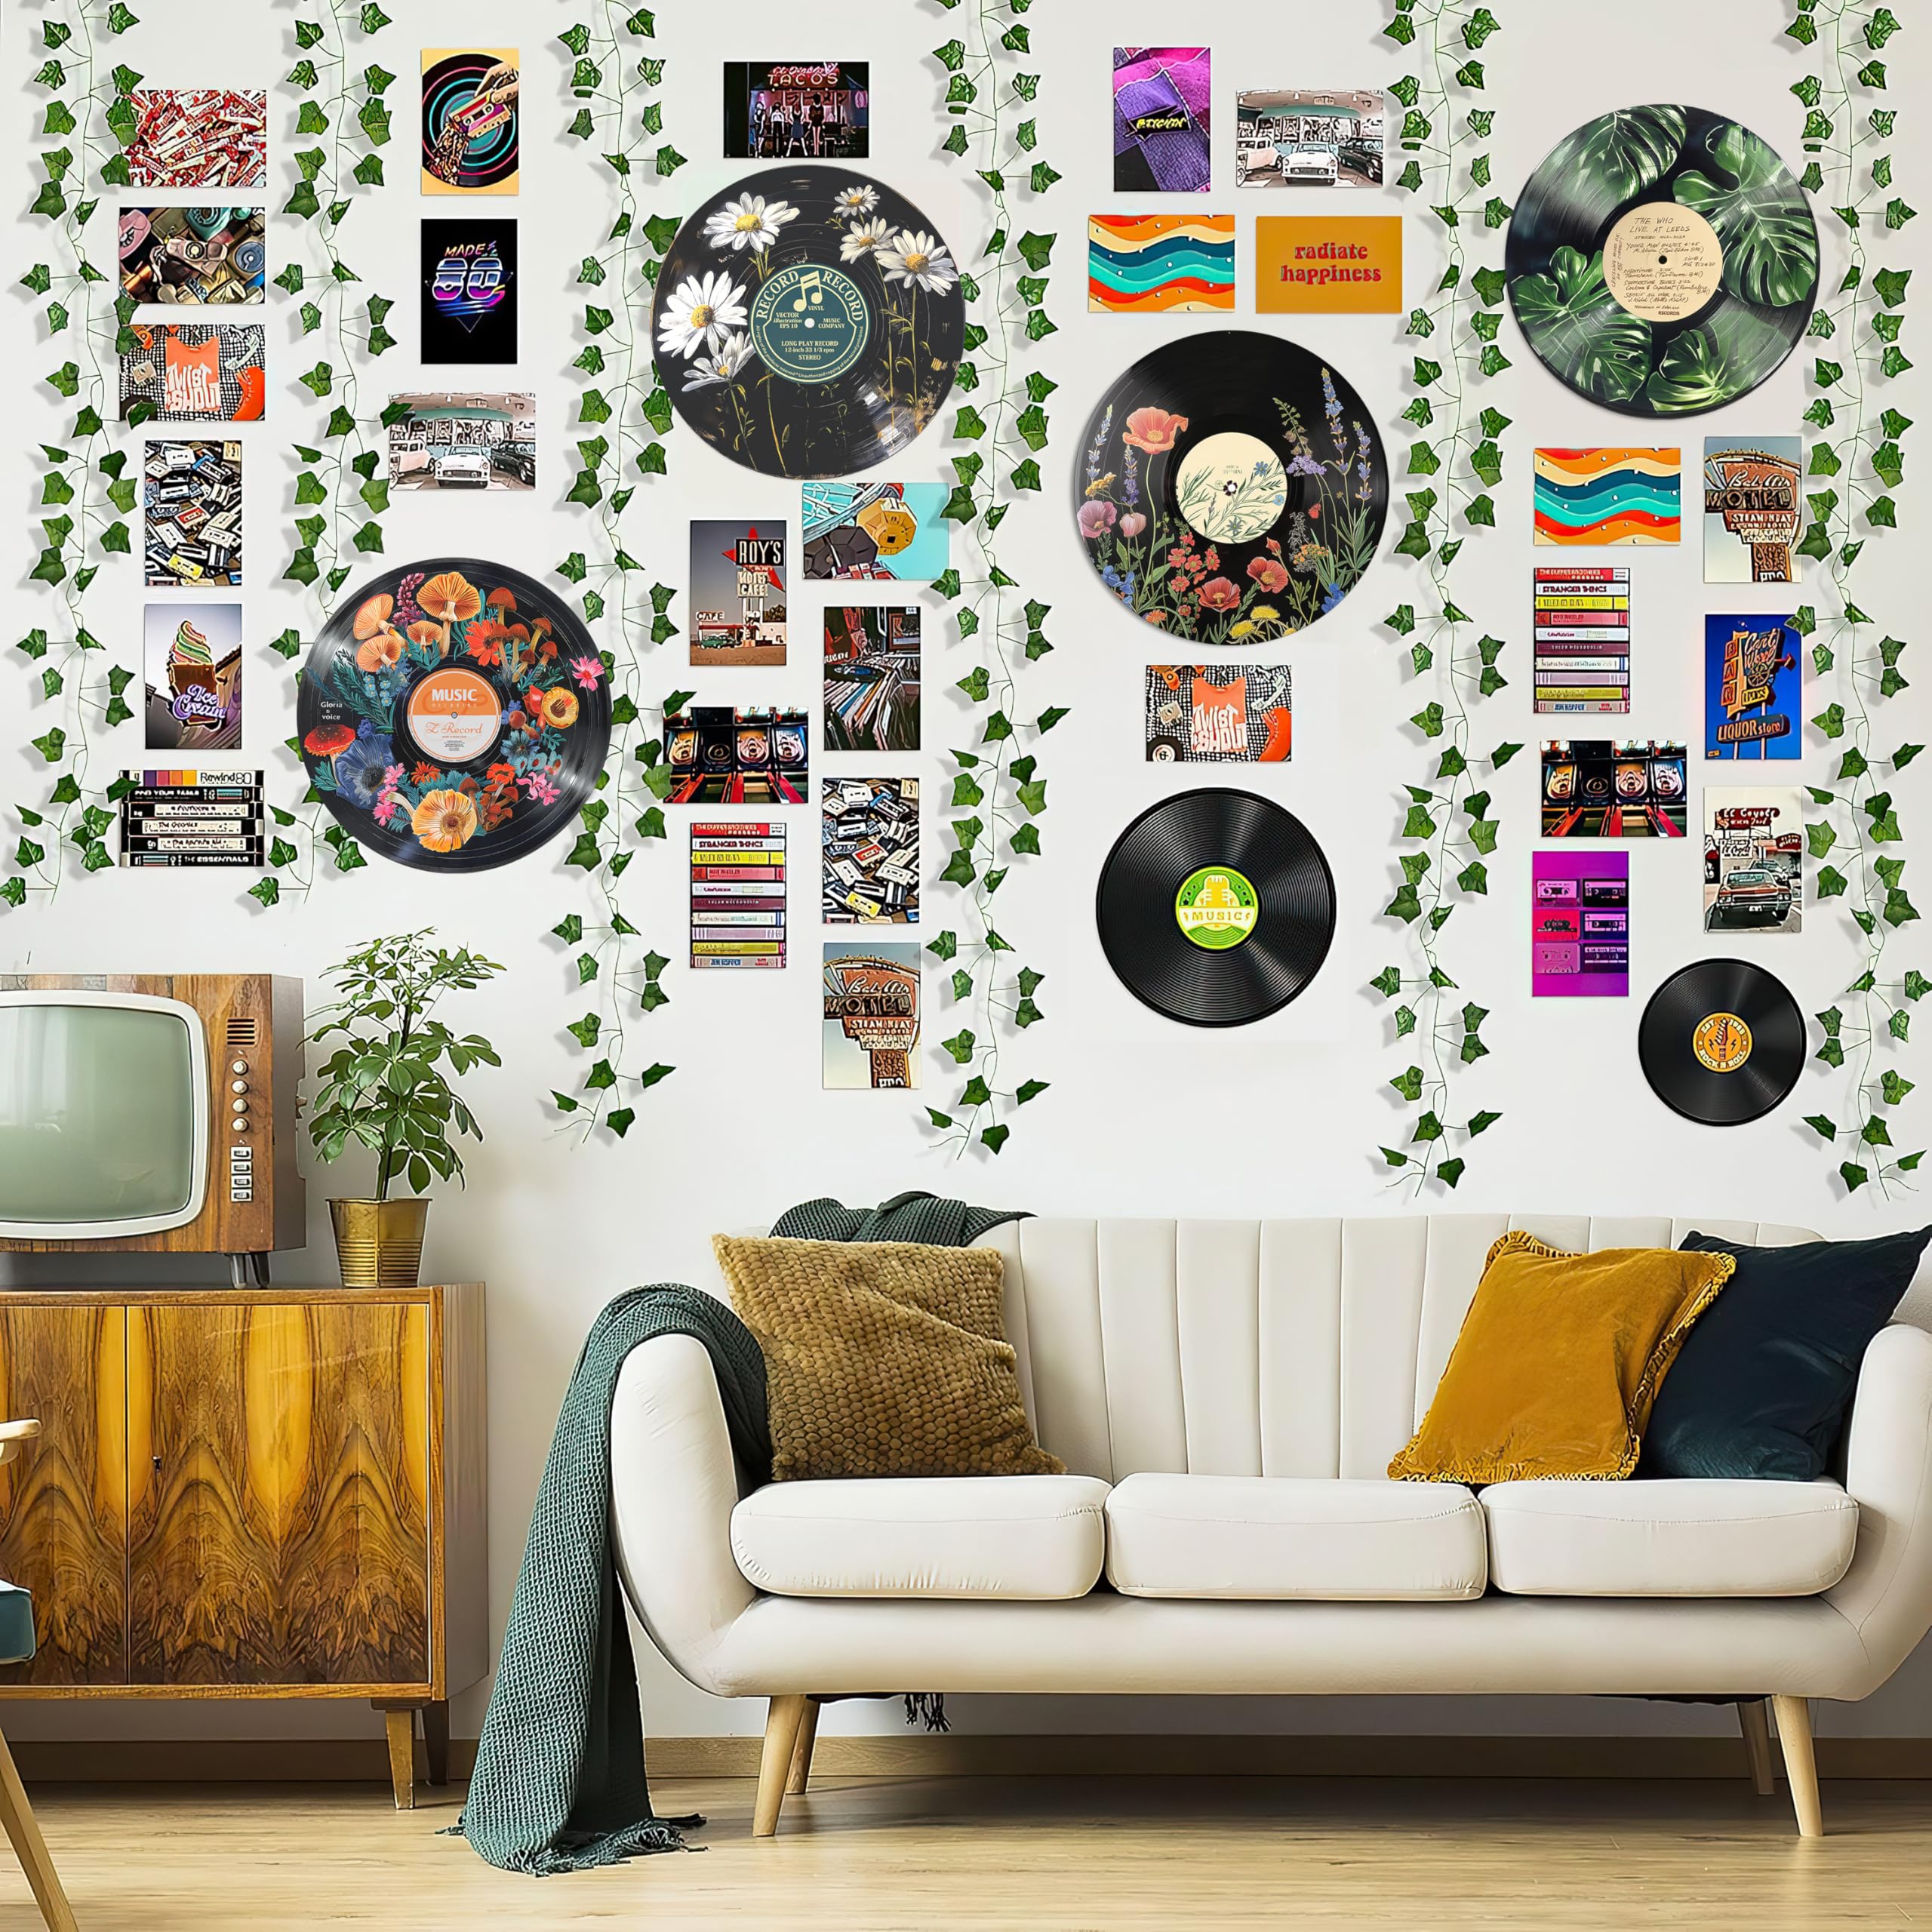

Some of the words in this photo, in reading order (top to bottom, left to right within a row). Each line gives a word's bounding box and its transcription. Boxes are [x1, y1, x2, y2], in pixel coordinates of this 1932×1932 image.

[767, 73, 838, 85] TACOS
[445, 243, 486, 257] MADE
[1295, 242, 1367, 260] radiate
[1626, 242, 1644, 251] YOUNG
[1281, 264, 1381, 285] happiness
[756, 270, 798, 320] RECORD
[823, 270, 863, 321] RECORD
[739, 540, 782, 565] ROY'S
[740, 584, 765, 595] CAFE
[697, 612, 723, 620] CAFE
[187, 684, 217, 705] Ice
[432, 688, 477, 700] MUSIC
[172, 694, 226, 720] Cream
[441, 721, 483, 734] Record
[1718, 720, 1757, 740] LIQUOR
[1192, 912, 1242, 921] MUSIC
